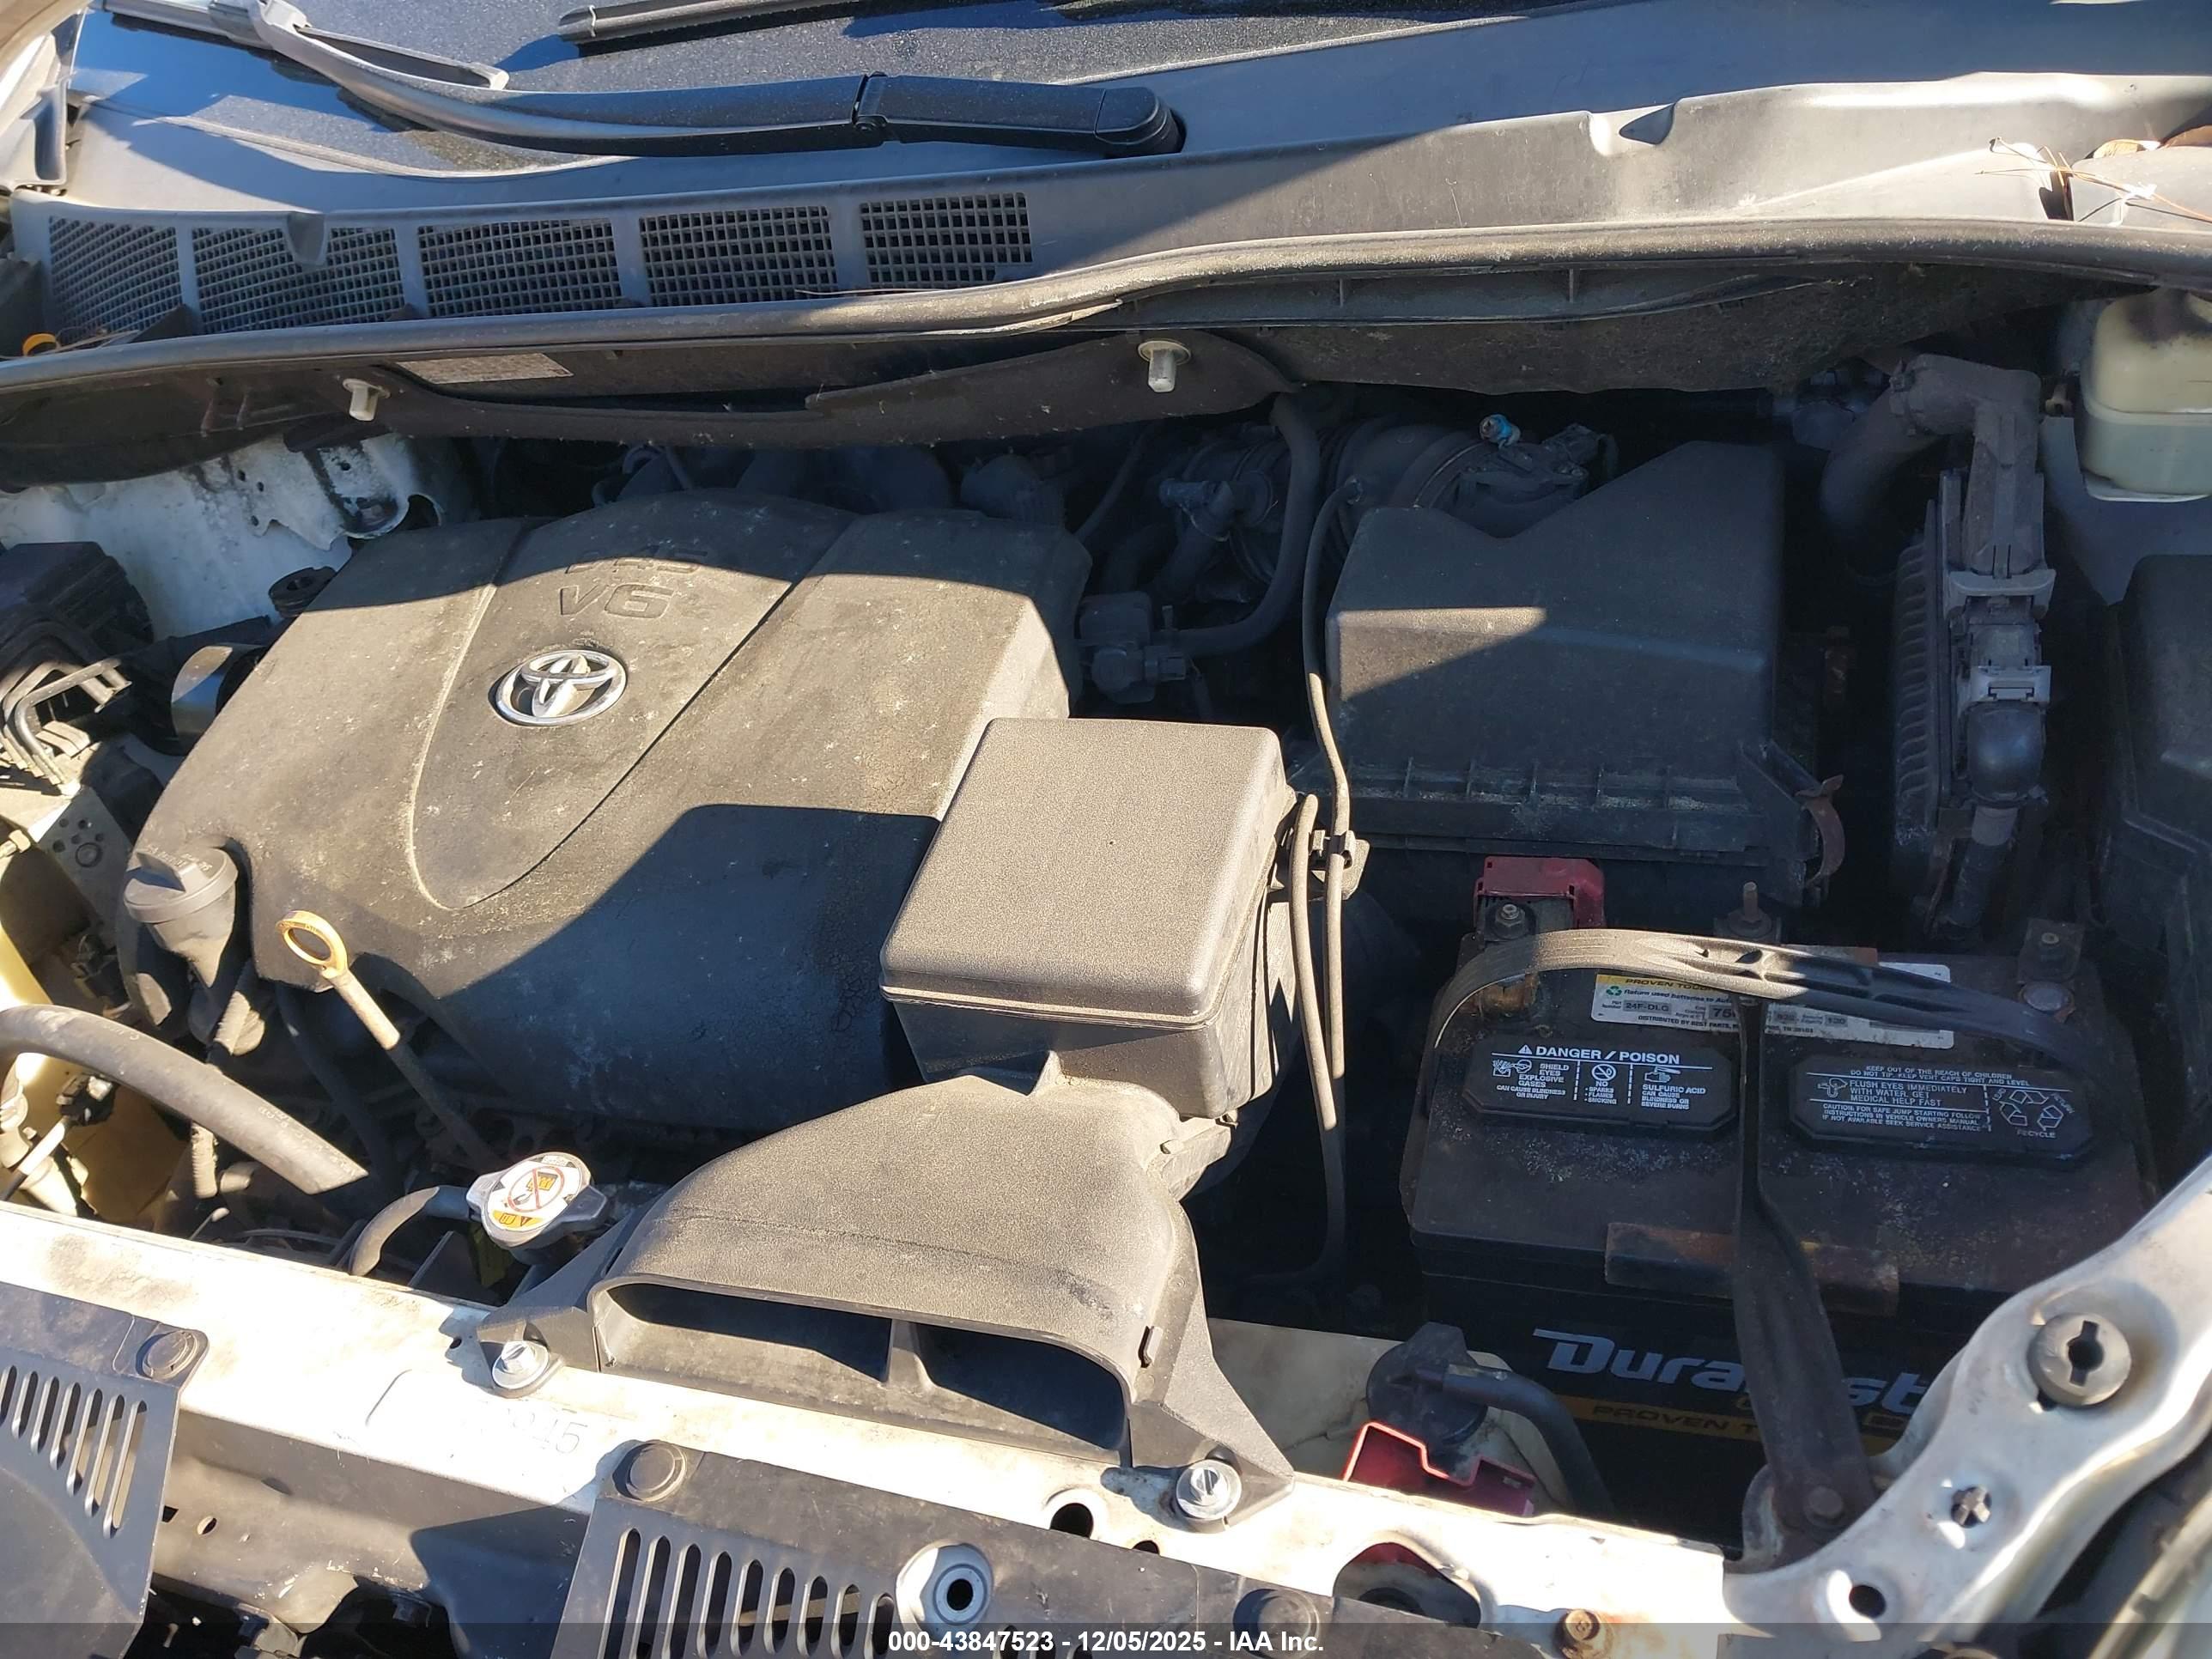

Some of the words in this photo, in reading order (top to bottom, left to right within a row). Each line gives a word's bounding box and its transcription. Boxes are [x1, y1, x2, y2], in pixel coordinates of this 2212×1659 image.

[559, 582, 676, 619] V6
[1626, 978, 1674, 988] PROVEN
[1671, 993, 1705, 1002] batteries
[1638, 1015, 1680, 1024] DISTRIBUTED
[1535, 1046, 1601, 1060] DANGER
[1620, 1053, 1680, 1064] POISON
[1518, 1074, 1565, 1083] EXPLOSIVE
[1642, 1084, 1685, 1093] SULFURIC
[1850, 1079, 1879, 1089] FLUSH
[1881, 1082, 1904, 1091] EYES
[1907, 1084, 1967, 1094] IMMEDIATELY
[1850, 1095, 1888, 1103] MEDICAL
[1824, 1109, 1874, 1118] INSTRUCTIONS
[1936, 1122, 1982, 1132] ASSISTANCE
[2017, 1129, 2057, 1139] RECYCLE
[1532, 1328, 1932, 1415] Durast
[1592, 1405, 1729, 1431] PROVEN
